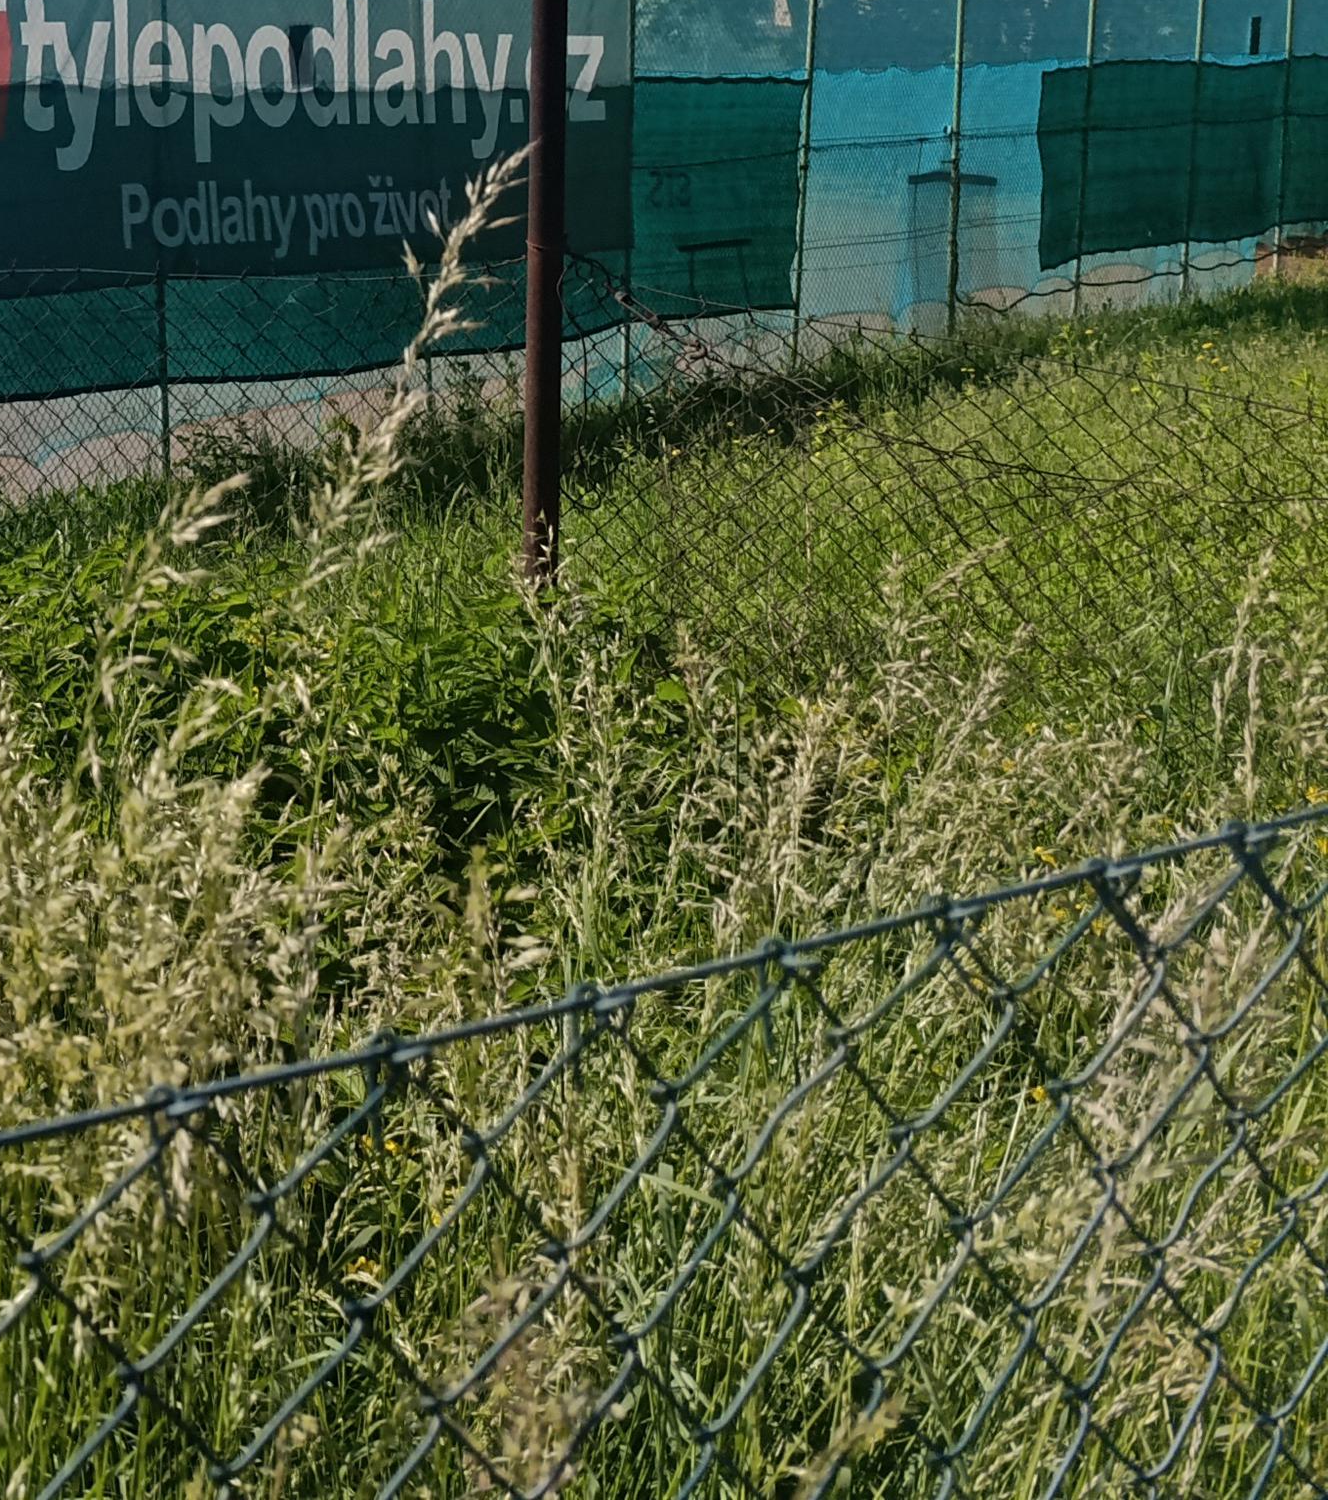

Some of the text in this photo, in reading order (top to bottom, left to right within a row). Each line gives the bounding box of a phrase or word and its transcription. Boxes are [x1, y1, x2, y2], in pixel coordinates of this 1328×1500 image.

[121, 175, 454, 258] Podlahy pro život
